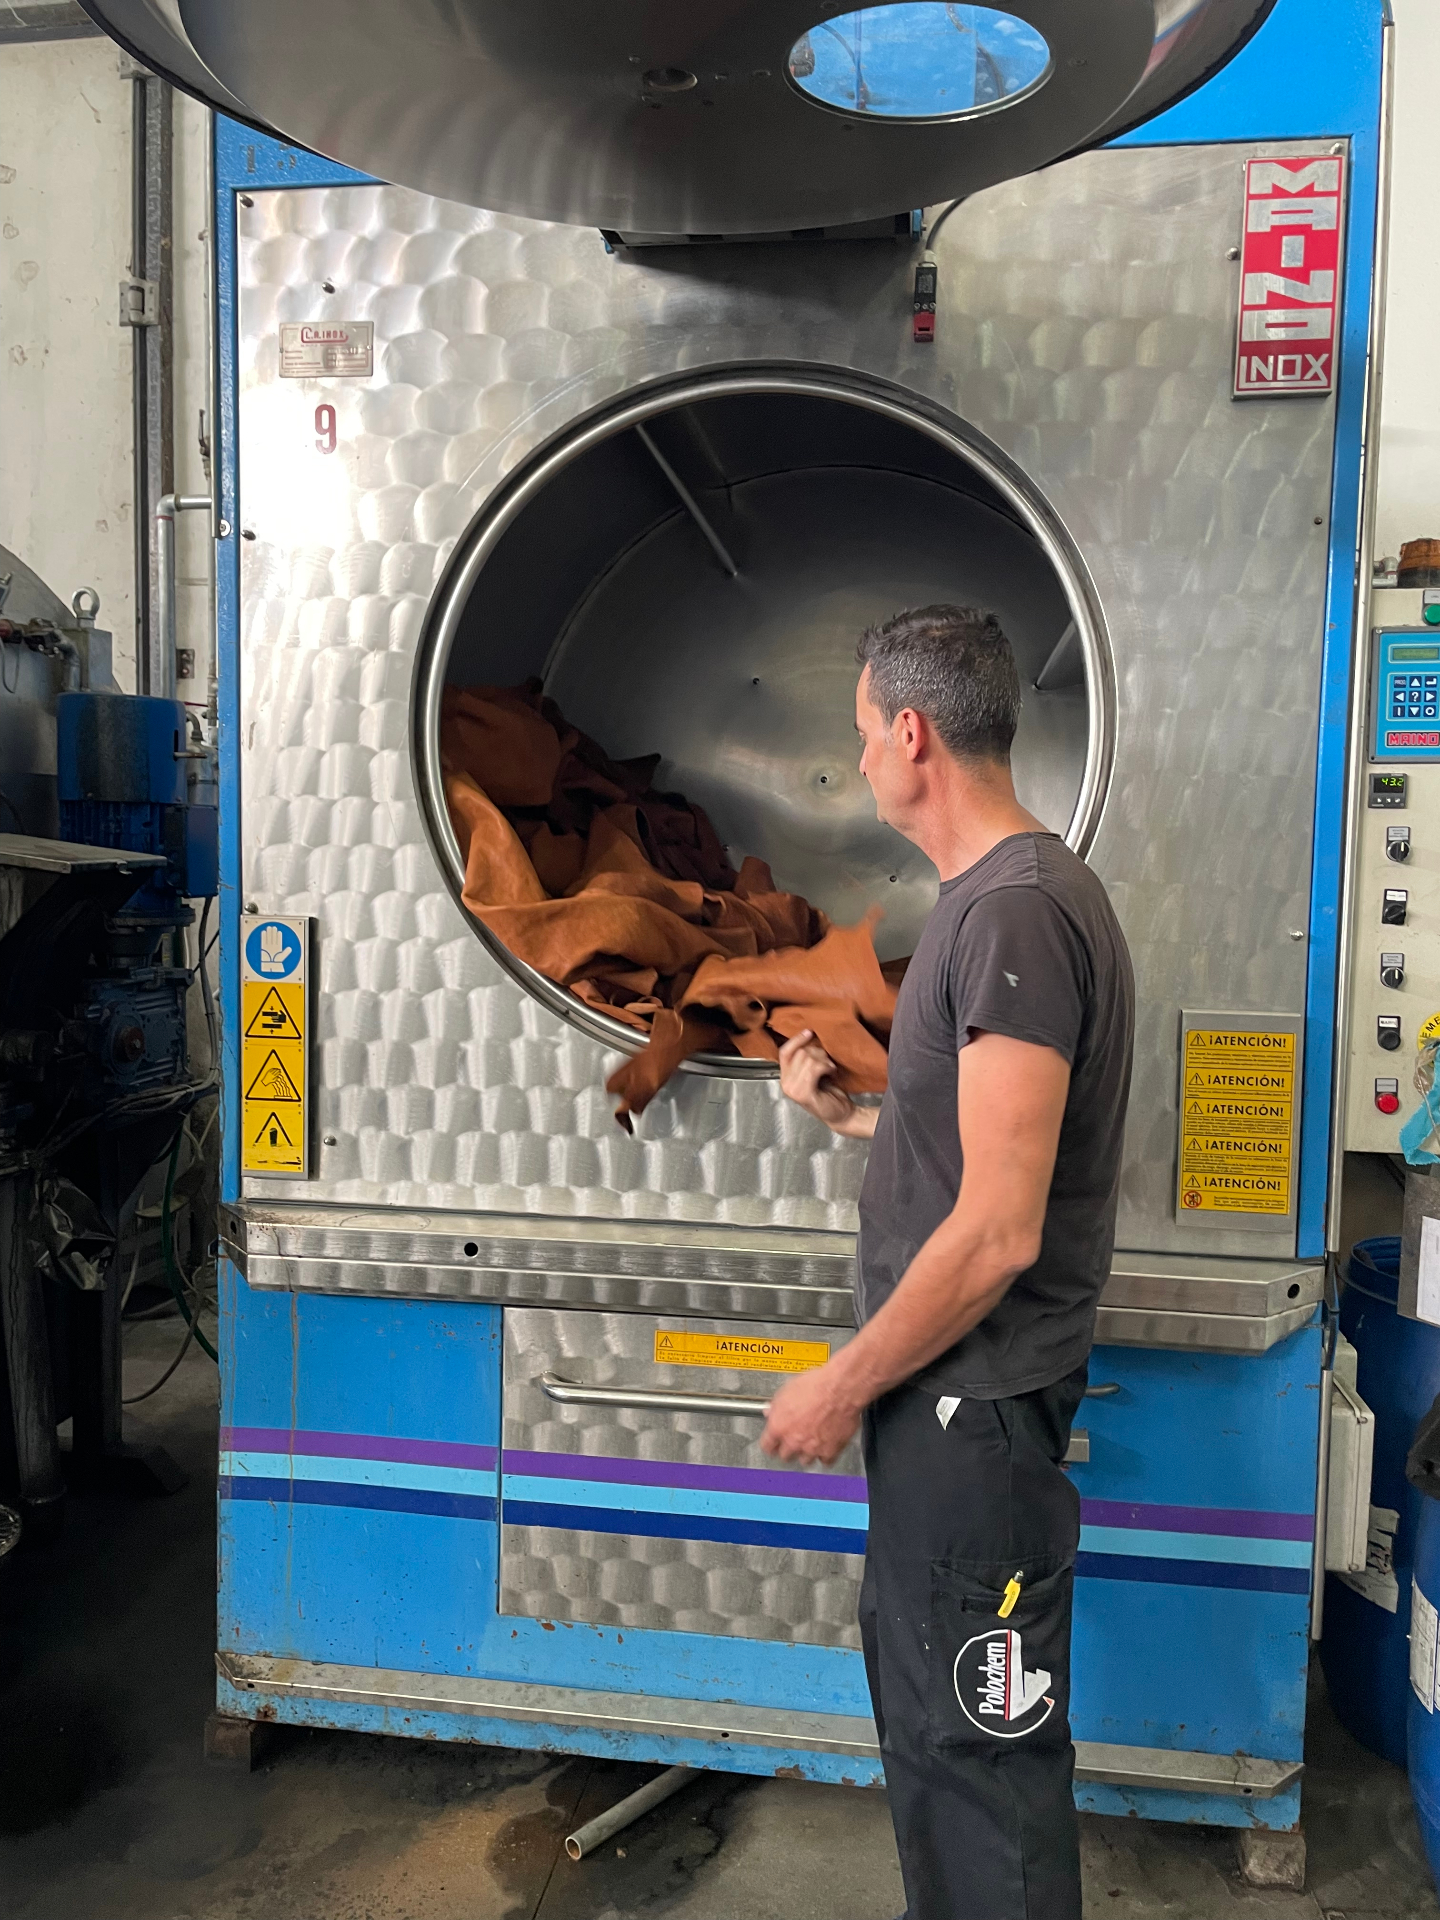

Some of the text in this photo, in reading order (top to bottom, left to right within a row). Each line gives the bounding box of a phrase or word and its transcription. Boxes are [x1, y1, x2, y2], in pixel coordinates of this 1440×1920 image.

[1241, 159, 1340, 342] MAINO
[1238, 353, 1330, 389] INOX
[314, 403, 338, 454] 9
[1388, 733, 1439, 746] MAINO
[1209, 1034, 1287, 1048] ¡ATENCIÓN!
[1207, 1074, 1285, 1088] ¡ATENCIÓN!
[1206, 1103, 1284, 1117] ¡ATENCIÓN!
[1205, 1139, 1282, 1154] ¡ATENCIÓN!
[1204, 1176, 1281, 1191] ¡ATENCIÓN!
[716, 1340, 784, 1355] ¡ATENCIÓN!
[976, 1642, 1006, 1715] Polochem
